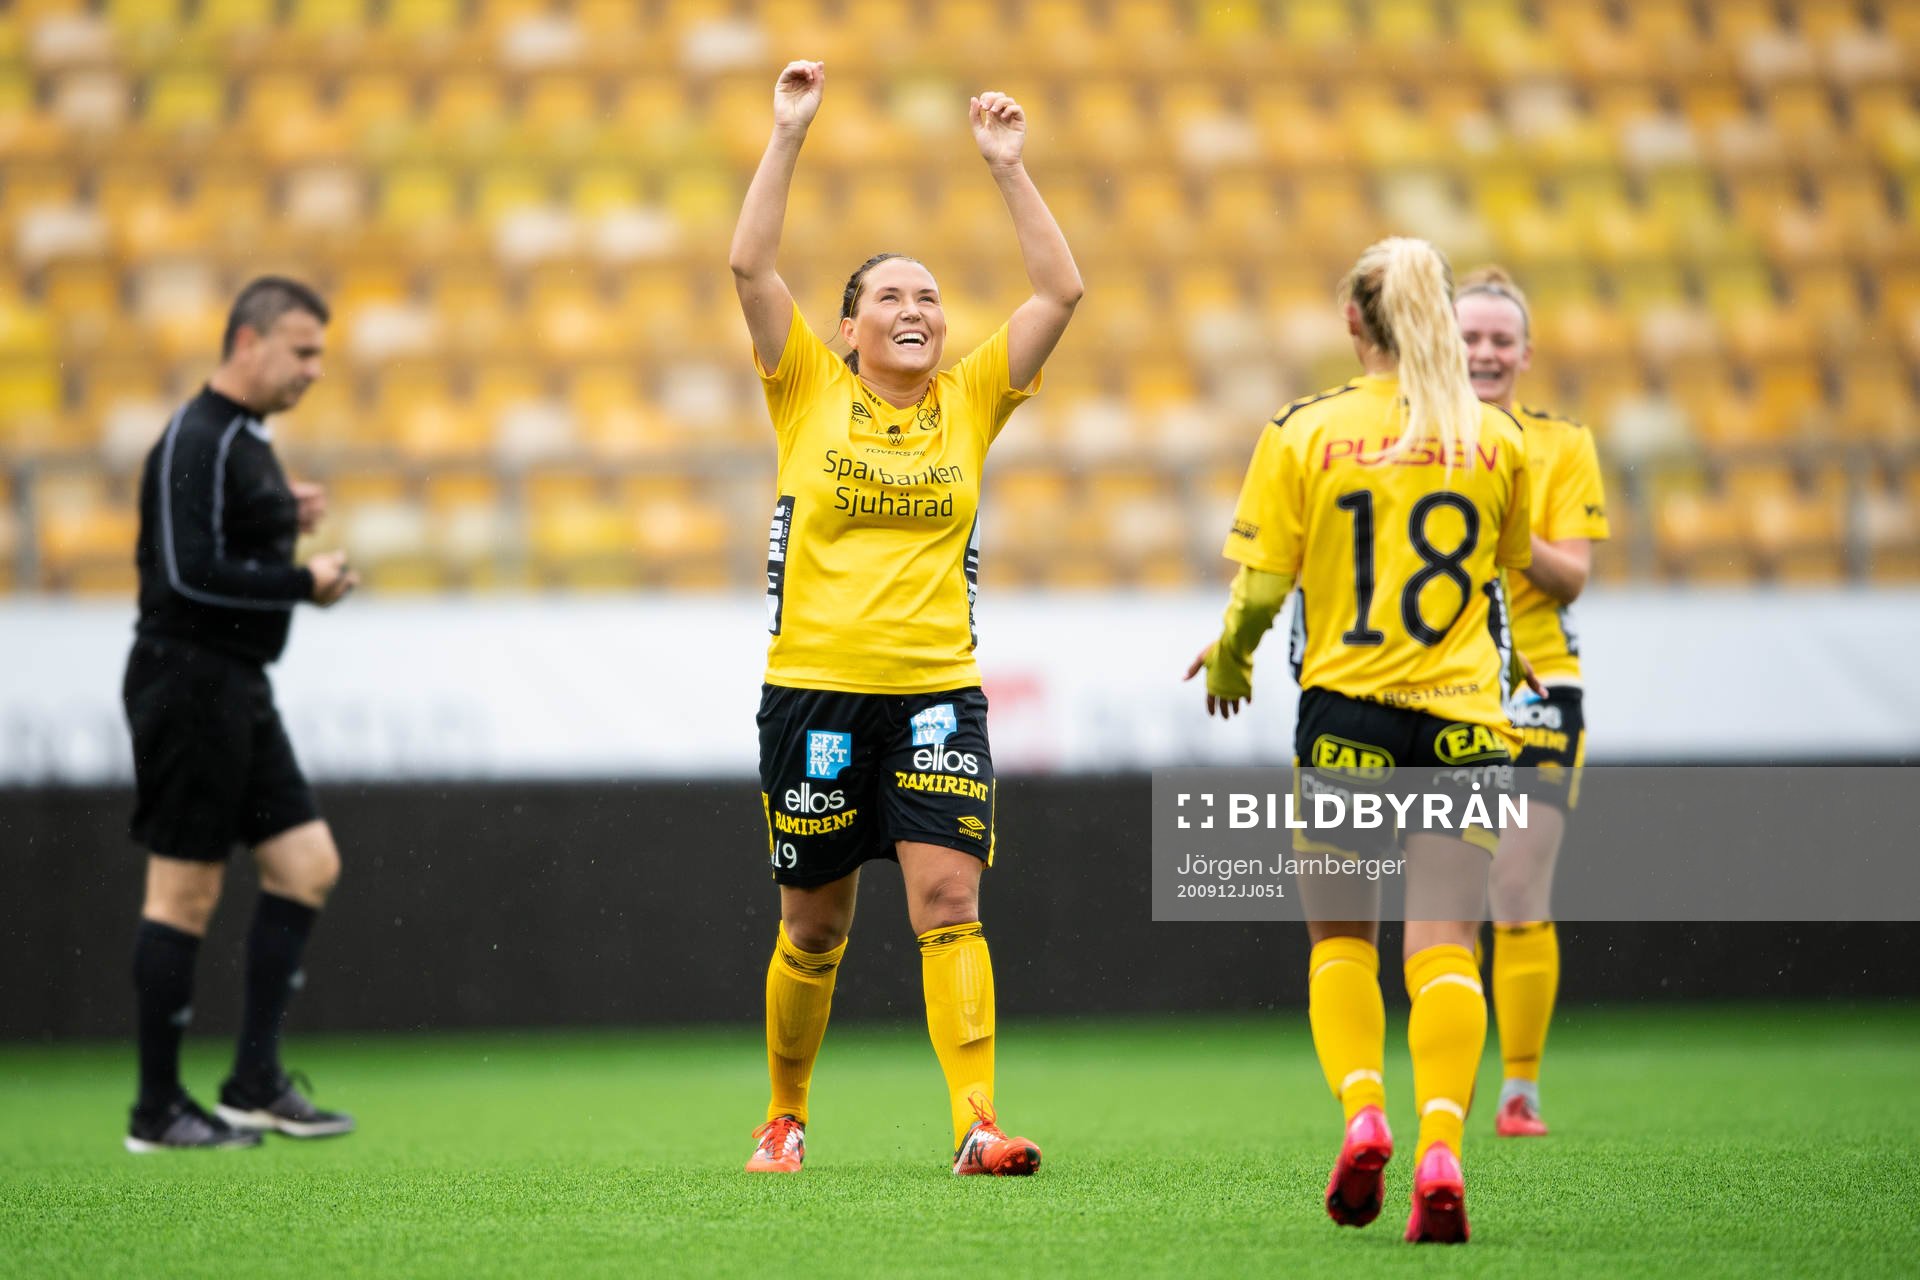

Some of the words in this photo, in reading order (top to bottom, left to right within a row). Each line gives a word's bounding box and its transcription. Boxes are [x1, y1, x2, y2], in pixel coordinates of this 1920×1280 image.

[823, 449, 964, 486] Sparbanken
[865, 447, 911, 457] TOVEKS
[834, 486, 953, 518] Sjuhärad
[1336, 489, 1480, 648] 18
[913, 743, 979, 775] ellos
[1319, 741, 1386, 779] EAB
[785, 782, 846, 813] ellos
[895, 772, 989, 801] RAMIRENT
[775, 809, 858, 836] RAMIRENT
[958, 827, 983, 840] umbro
[774, 840, 798, 869] 19
